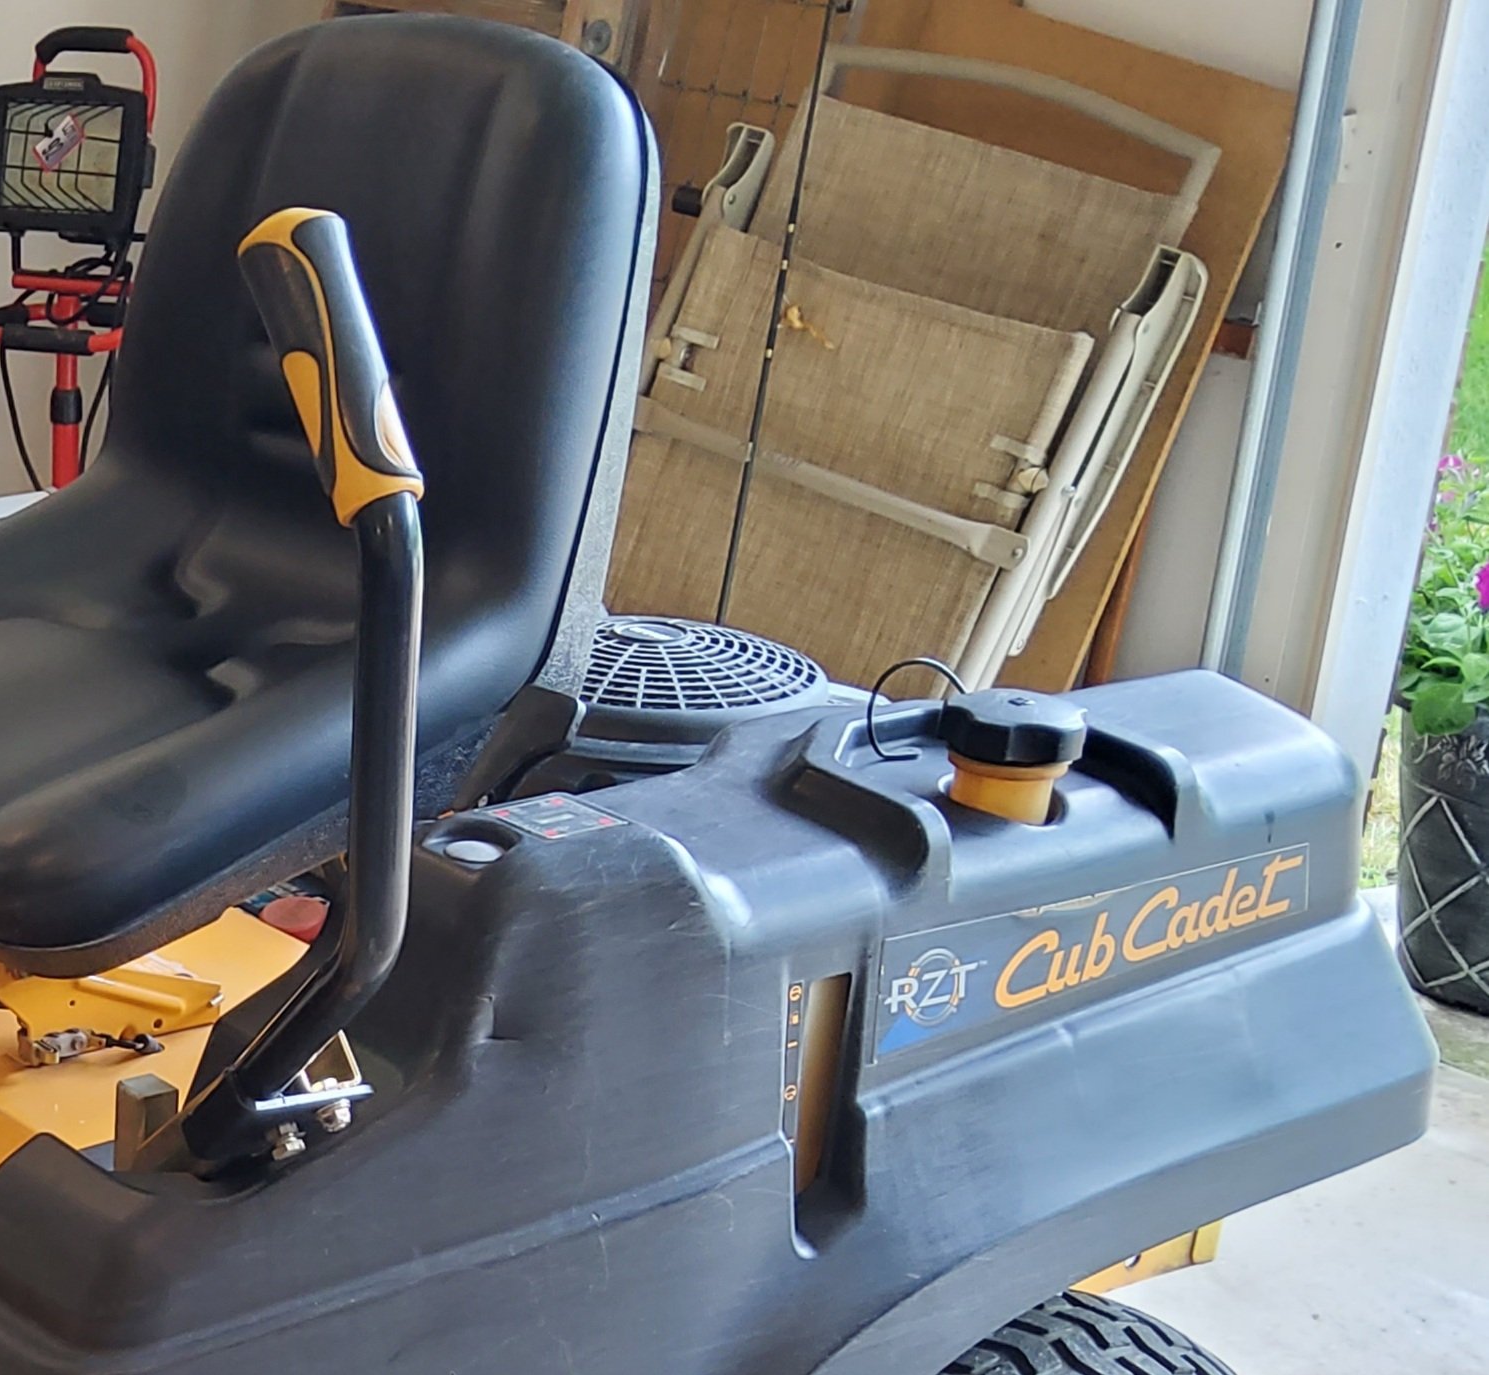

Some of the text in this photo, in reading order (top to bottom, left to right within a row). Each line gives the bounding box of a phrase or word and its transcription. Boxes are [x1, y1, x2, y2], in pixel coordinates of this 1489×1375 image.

[995, 853, 1304, 1009] Cub Cadet
[884, 961, 980, 1014] RZT
